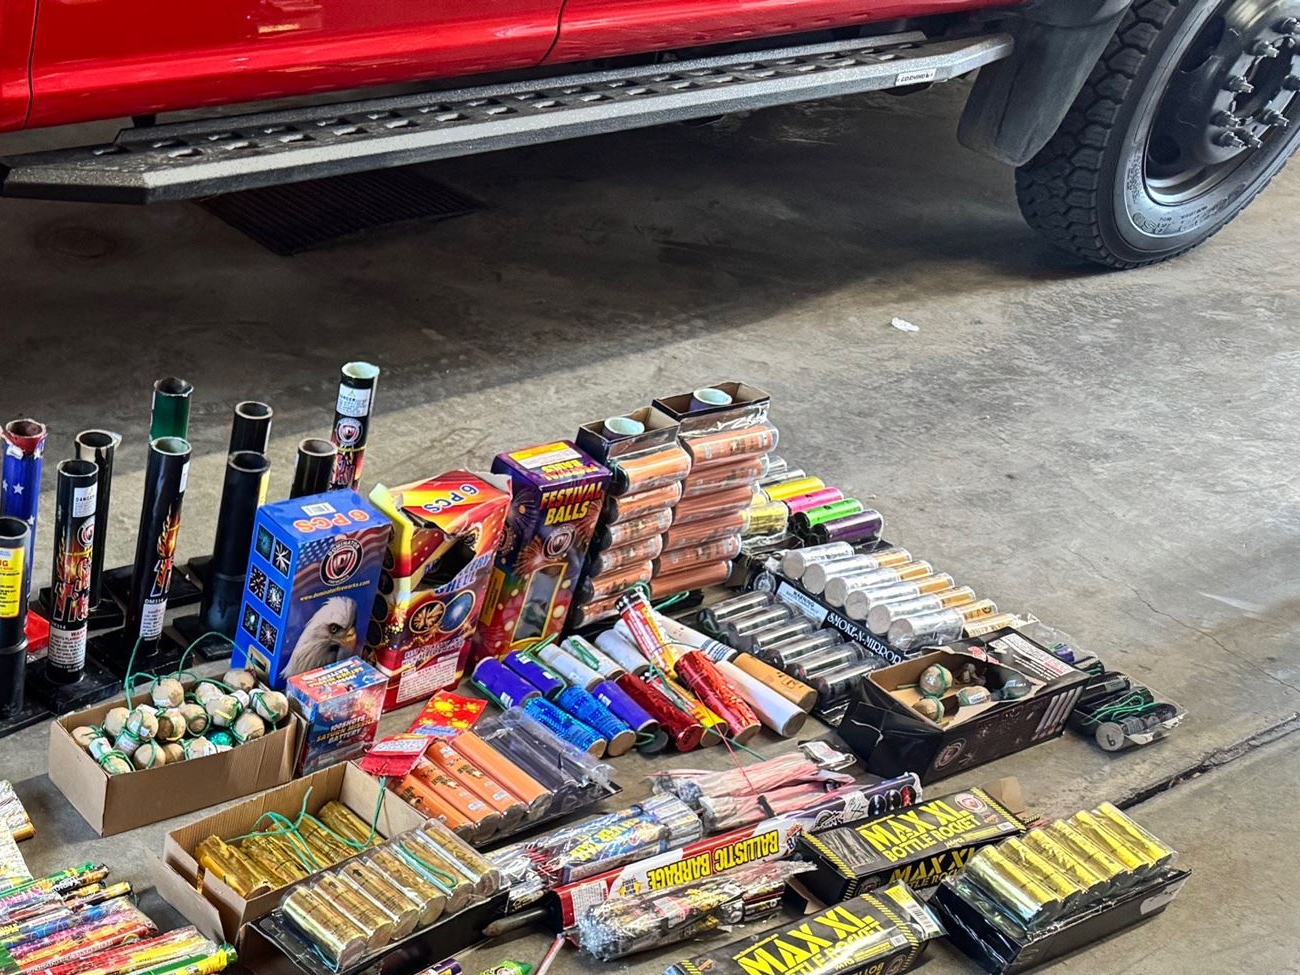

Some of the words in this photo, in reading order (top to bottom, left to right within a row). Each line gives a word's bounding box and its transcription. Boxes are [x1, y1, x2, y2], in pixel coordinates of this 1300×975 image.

[424, 492, 464, 513] PCS
[461, 484, 479, 497] 6
[541, 481, 604, 510] FESTIVAL
[293, 513, 352, 533] PCS
[348, 509, 370, 522] 6
[544, 500, 590, 526] BALLS
[827, 611, 903, 665] SMOKE-N-MIRROR
[858, 810, 937, 852] MAX
[919, 800, 972, 825] XL
[882, 832, 937, 863] BOTTLE
[933, 815, 981, 843] ROCKET
[714, 829, 780, 873] BALLISTIC
[646, 854, 712, 891] BARRAGE
[814, 905, 875, 940] XL
